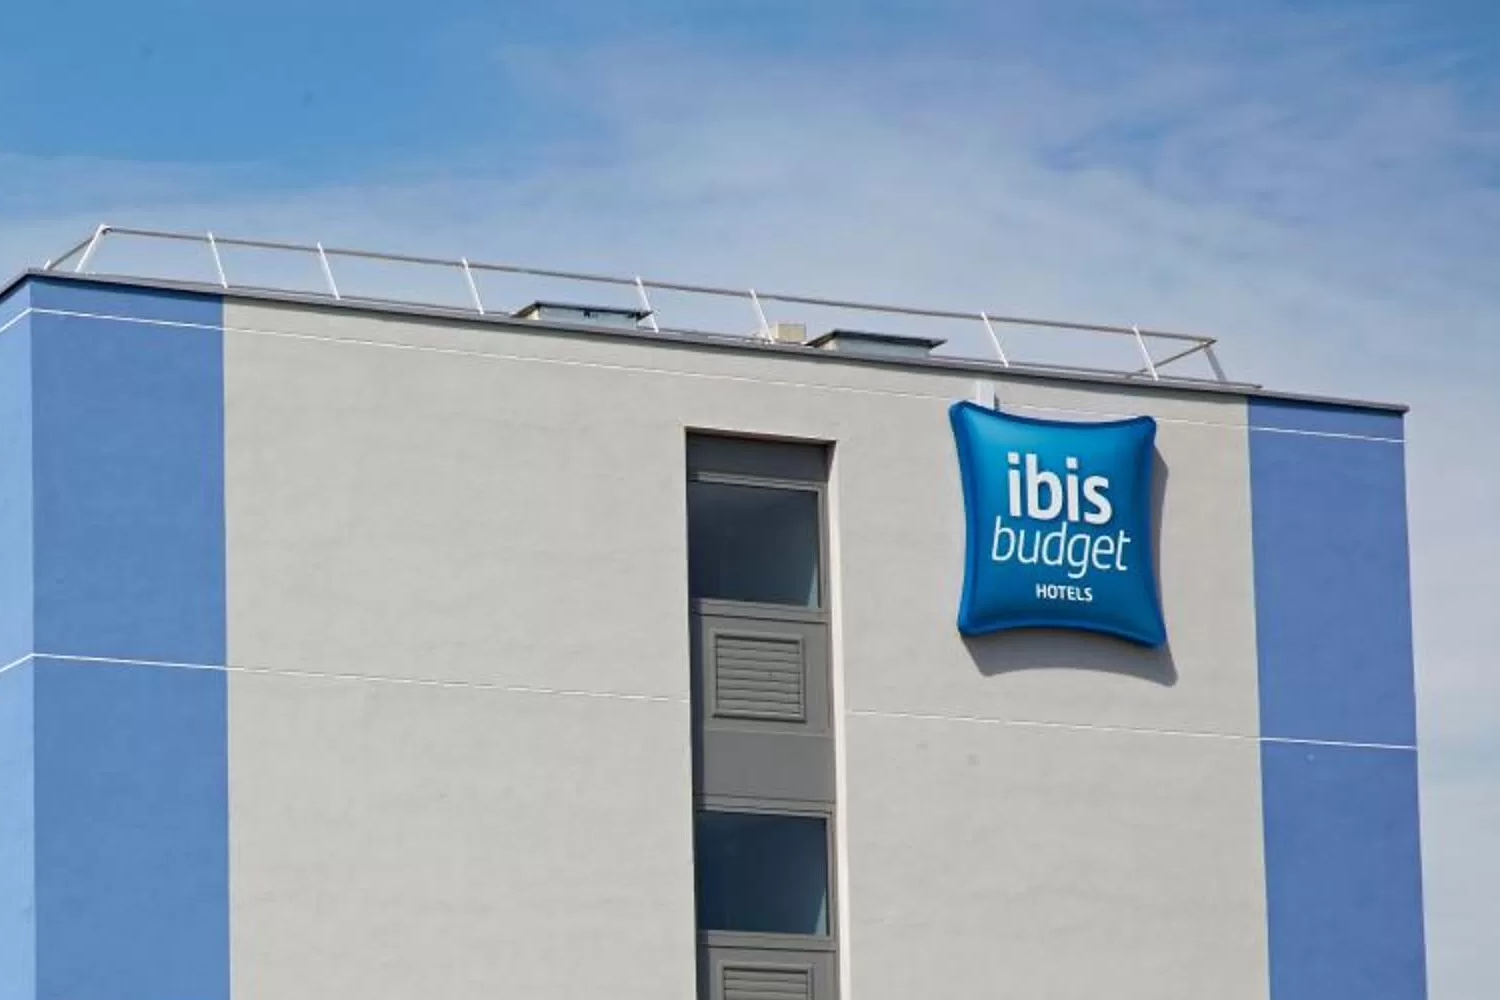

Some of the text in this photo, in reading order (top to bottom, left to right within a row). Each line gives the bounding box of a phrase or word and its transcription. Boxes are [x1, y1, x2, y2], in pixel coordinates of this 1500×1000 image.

[1007, 451, 1113, 525] ibis
[991, 515, 1131, 579] budget
[1035, 583, 1093, 602] HOTELS
